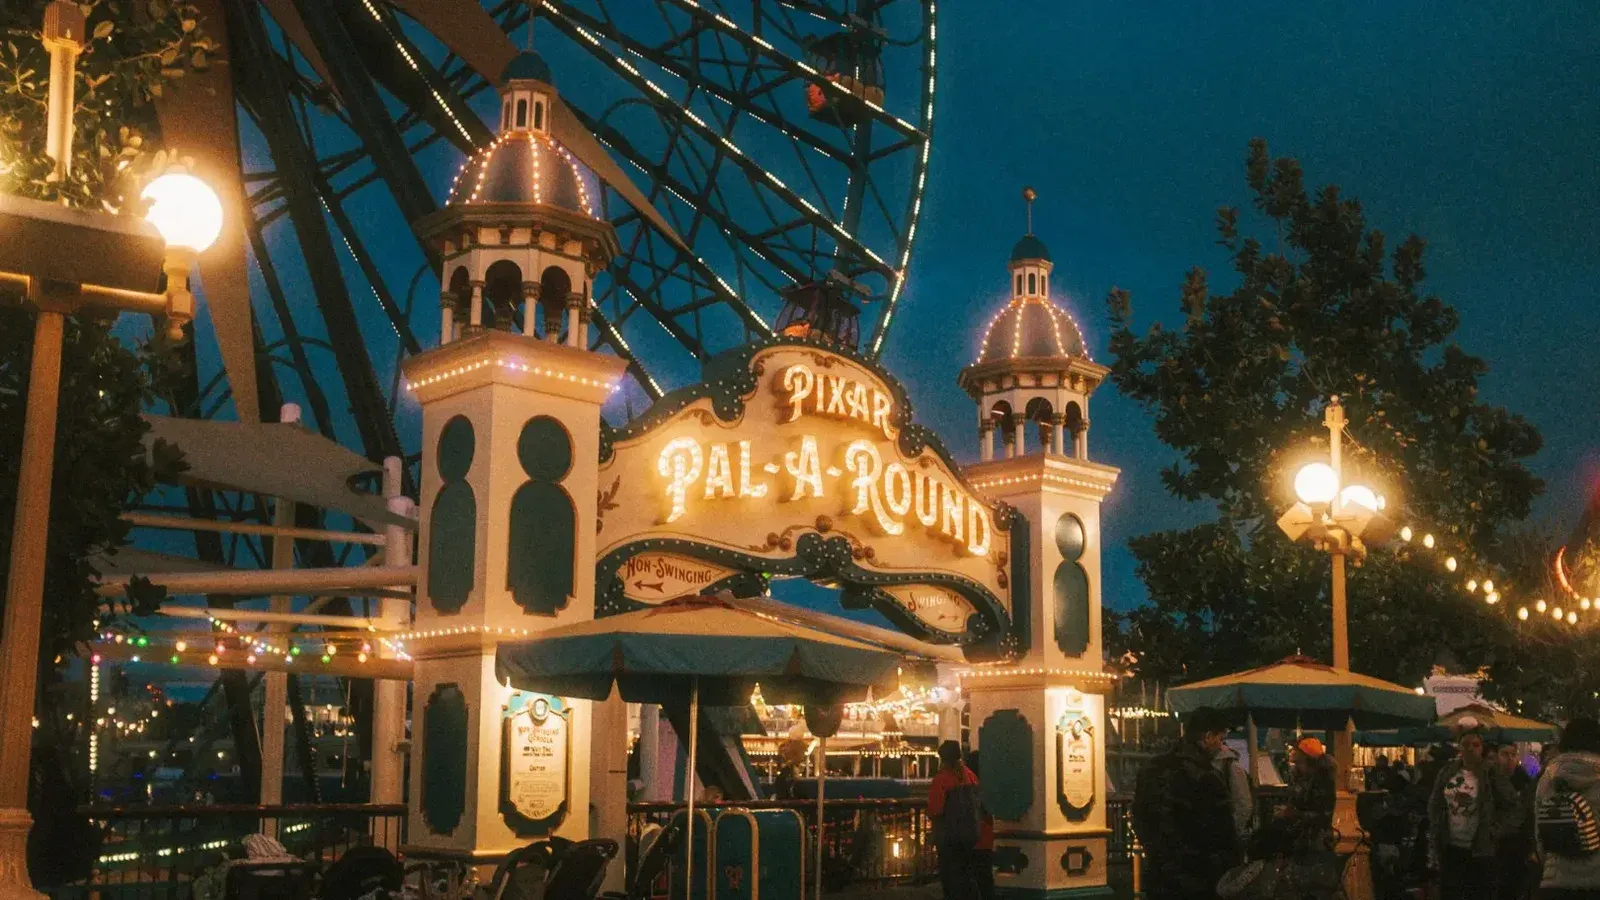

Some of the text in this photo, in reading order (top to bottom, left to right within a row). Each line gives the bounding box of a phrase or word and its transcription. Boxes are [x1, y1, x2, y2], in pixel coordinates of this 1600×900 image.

[783, 364, 897, 440] PIXAR
[657, 434, 991, 556] PAL-A-ROUND
[626, 556, 712, 585] NON-SWINGING
